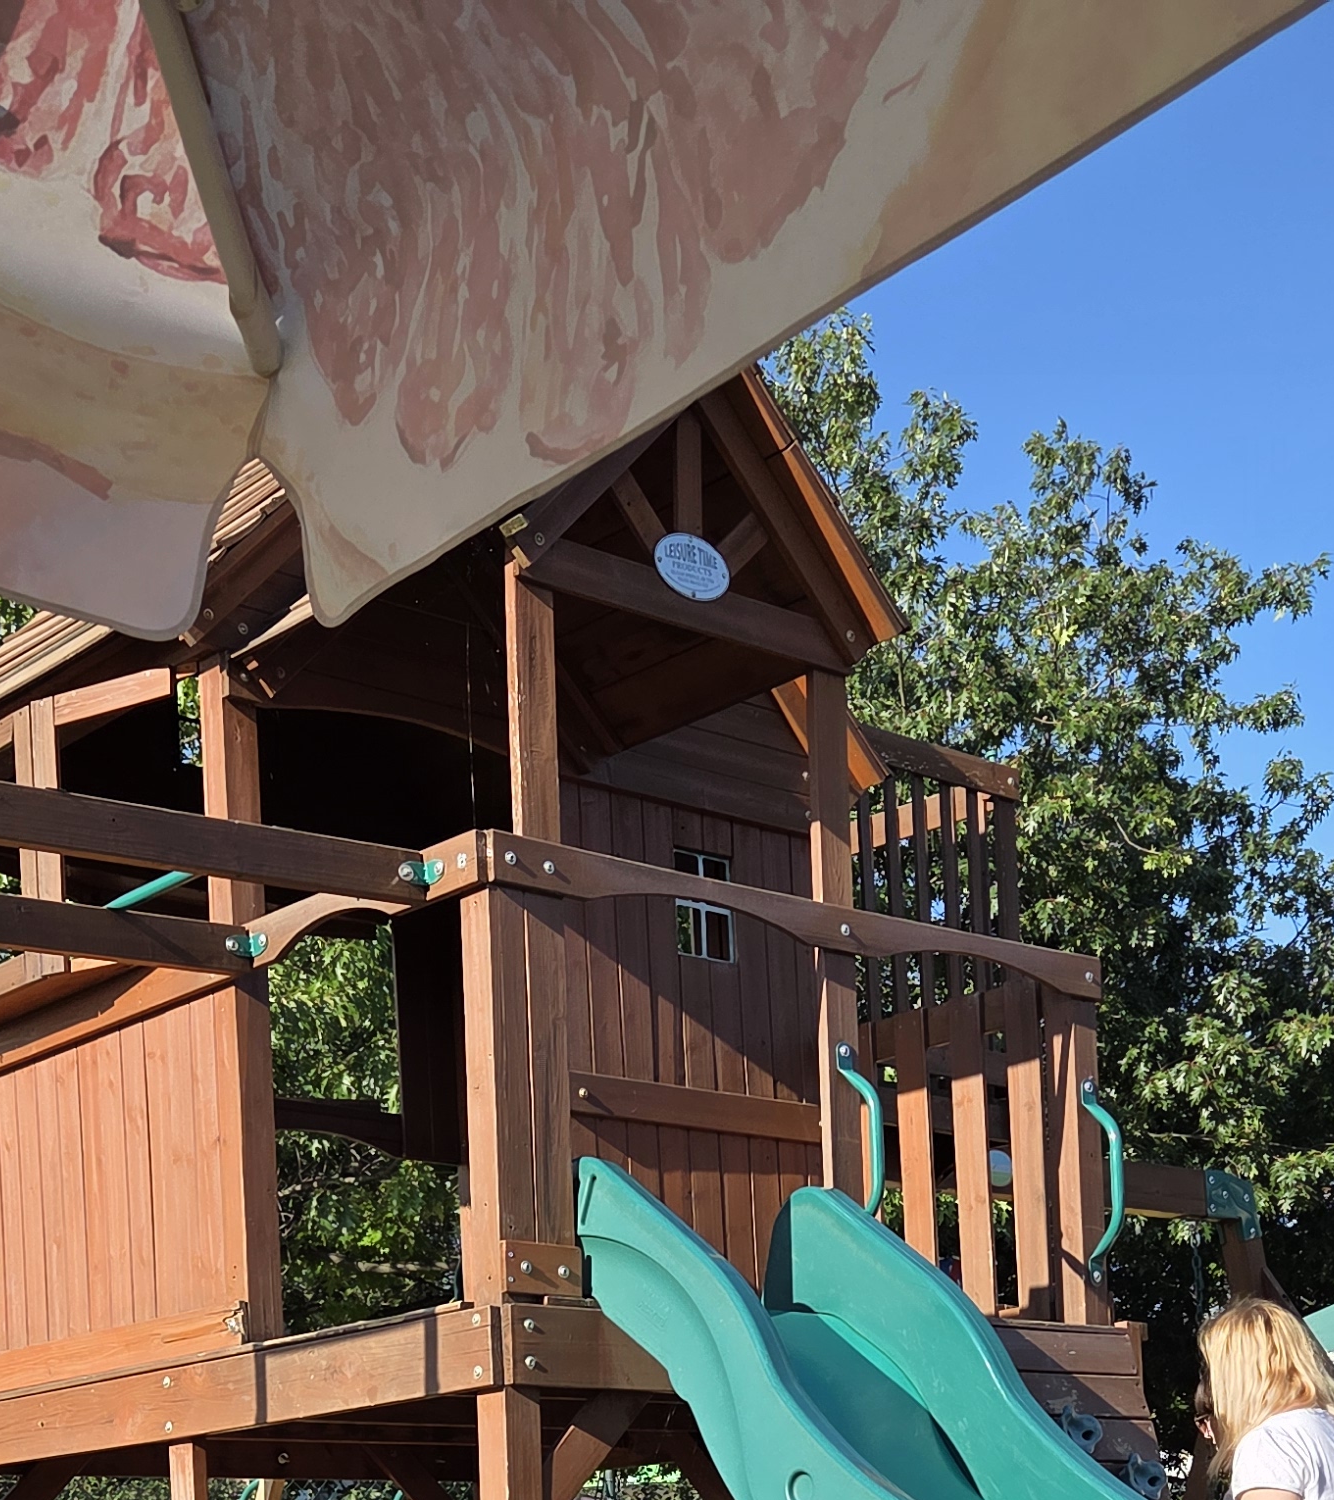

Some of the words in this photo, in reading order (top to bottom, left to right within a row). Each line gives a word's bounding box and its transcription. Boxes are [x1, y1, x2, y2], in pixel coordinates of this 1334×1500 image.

[665, 543, 697, 564] LEISURE
[698, 547, 718, 569] TIME
[672, 561, 713, 577] PRODUCTS
